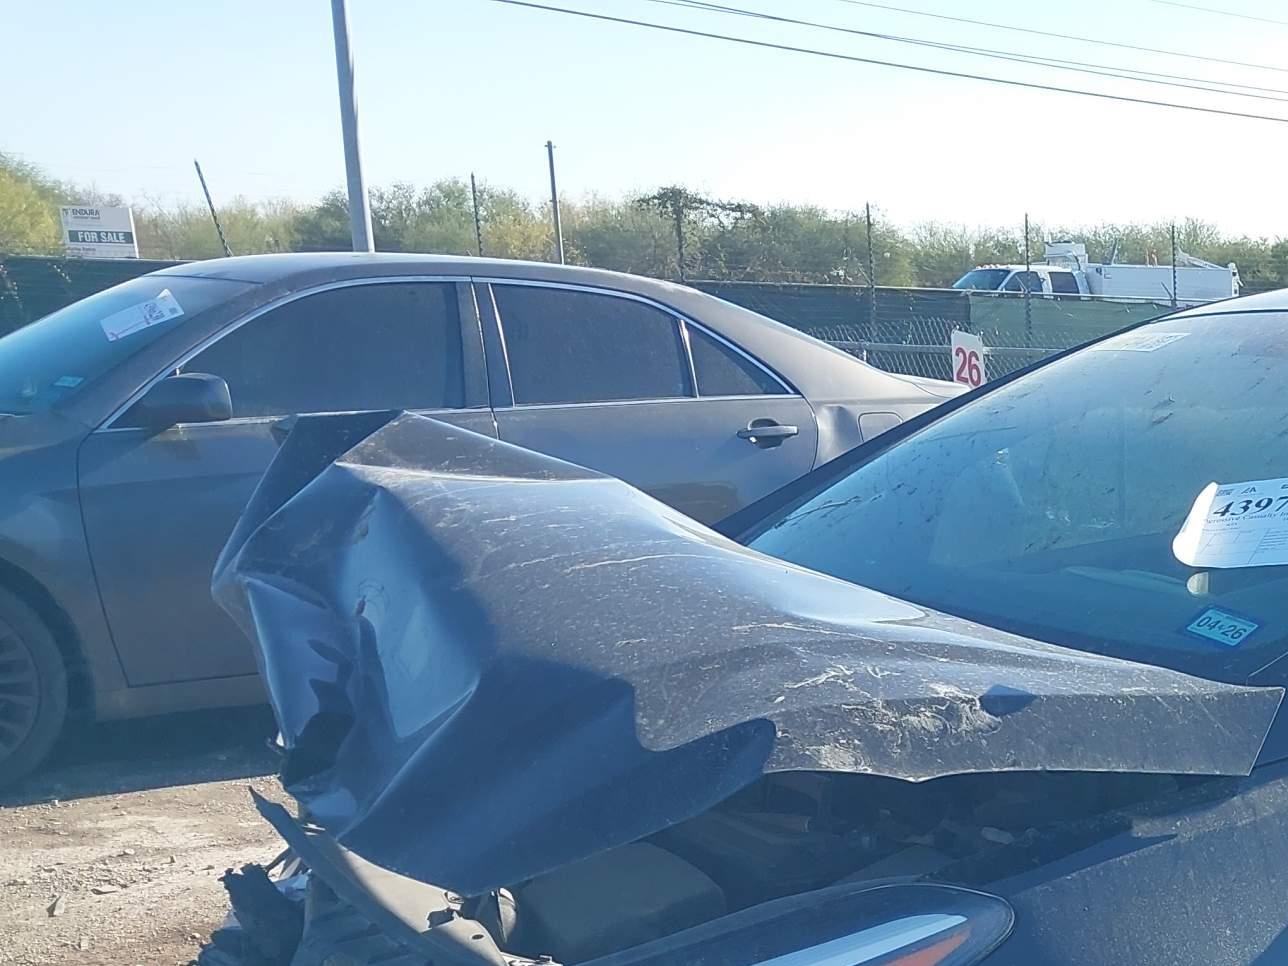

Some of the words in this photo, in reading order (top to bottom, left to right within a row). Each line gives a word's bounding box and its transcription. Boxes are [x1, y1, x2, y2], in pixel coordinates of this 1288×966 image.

[78, 231, 99, 242] FOR
[100, 232, 126, 243] SALE
[955, 346, 981, 387] 26
